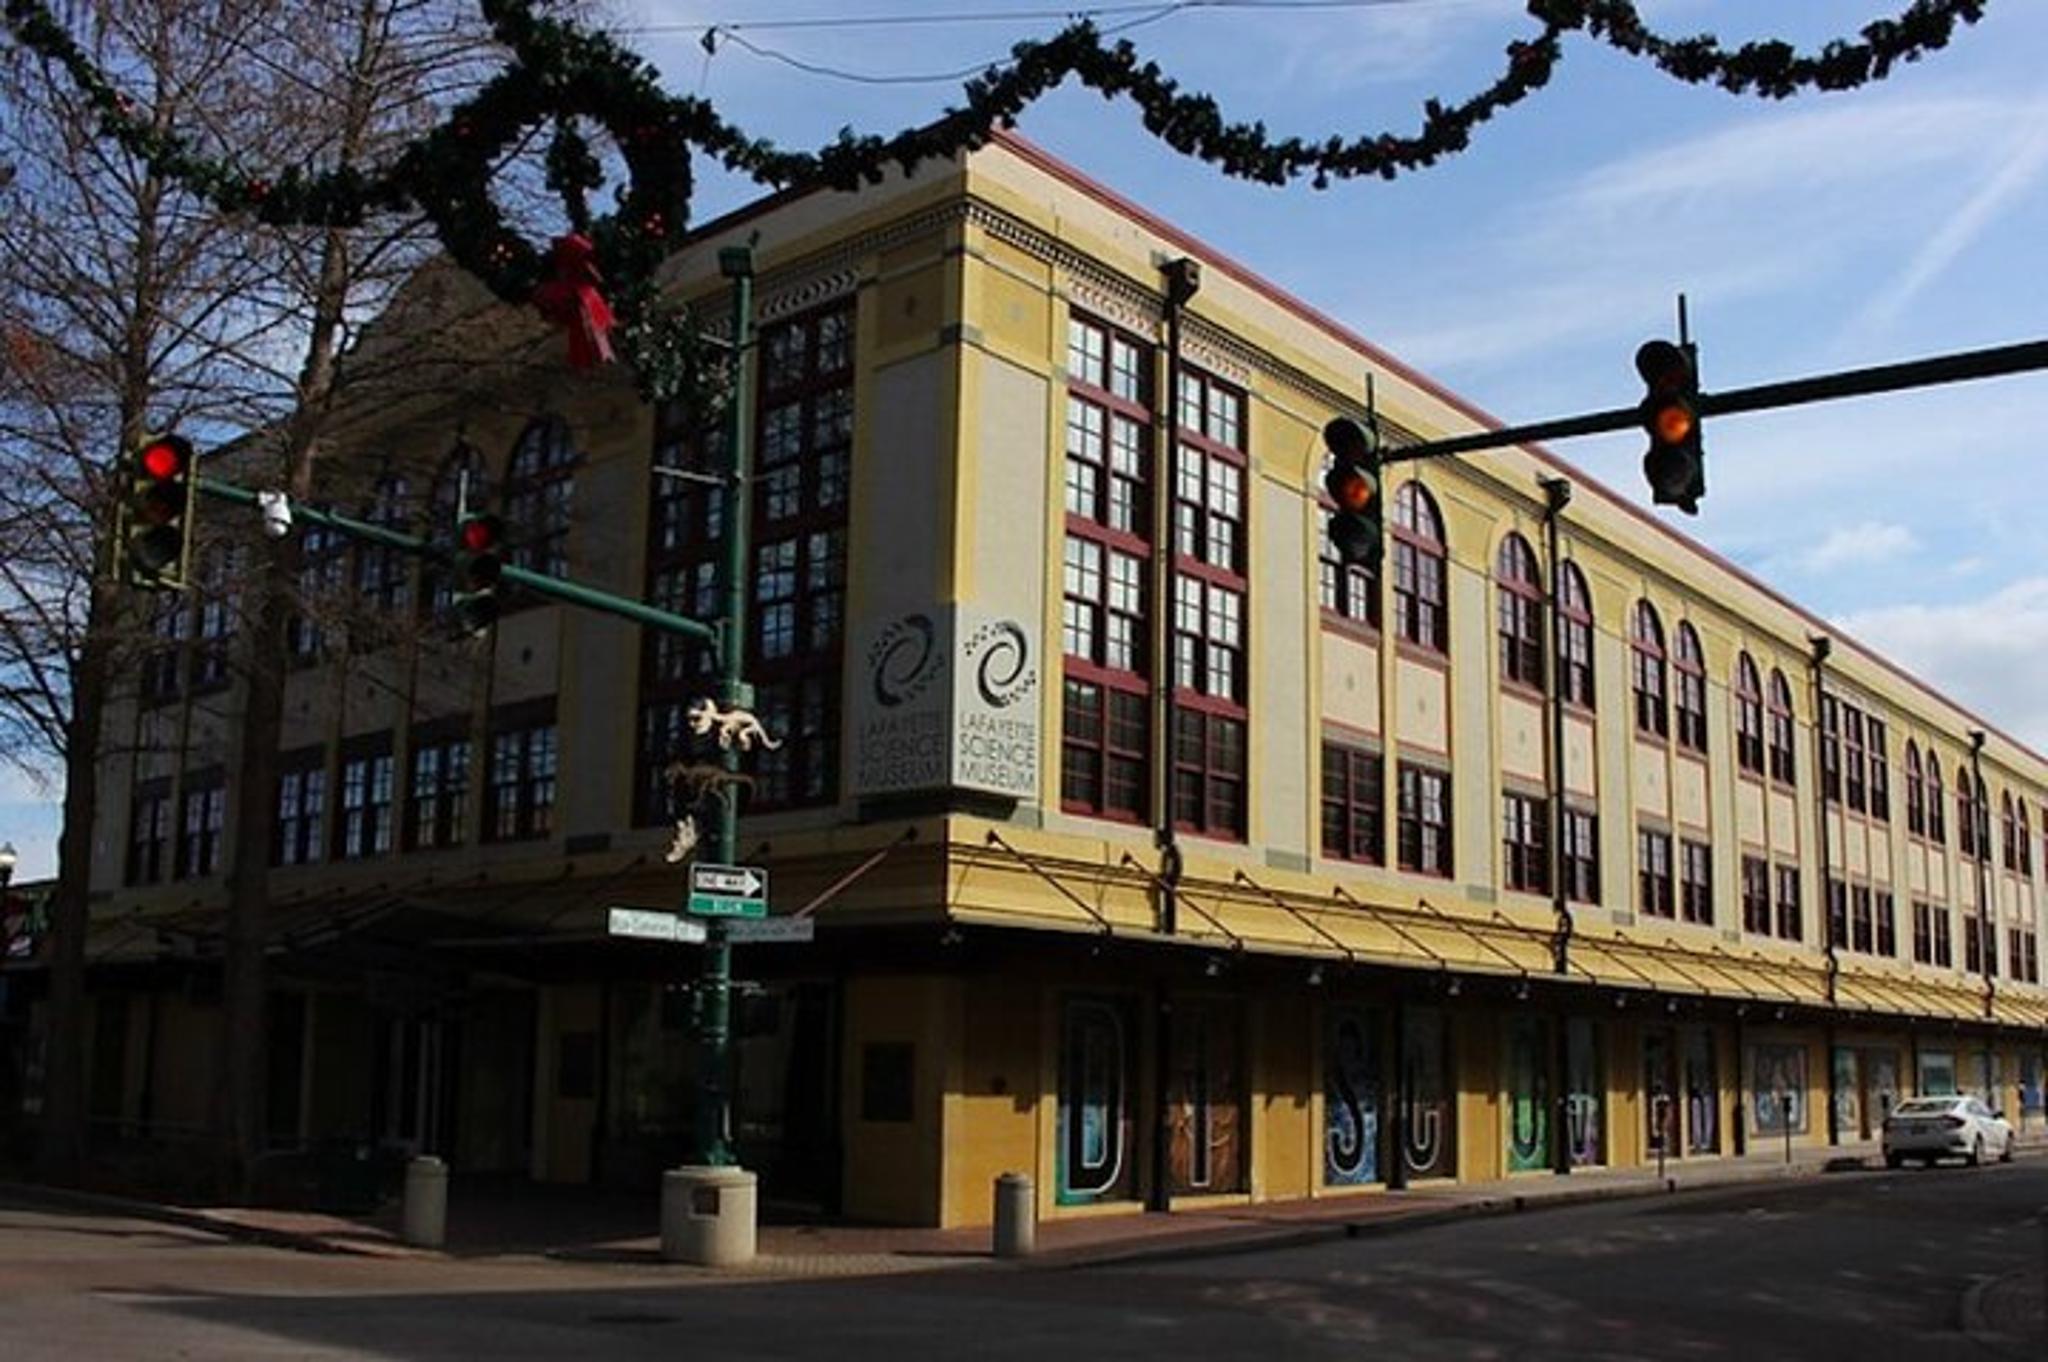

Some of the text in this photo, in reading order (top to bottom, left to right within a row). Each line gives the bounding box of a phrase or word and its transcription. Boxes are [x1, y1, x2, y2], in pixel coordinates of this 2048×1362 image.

[959, 712, 1036, 743] LAFAYETTE
[959, 732, 1036, 769] SCIENCE
[959, 760, 1036, 790] MUSEUM
